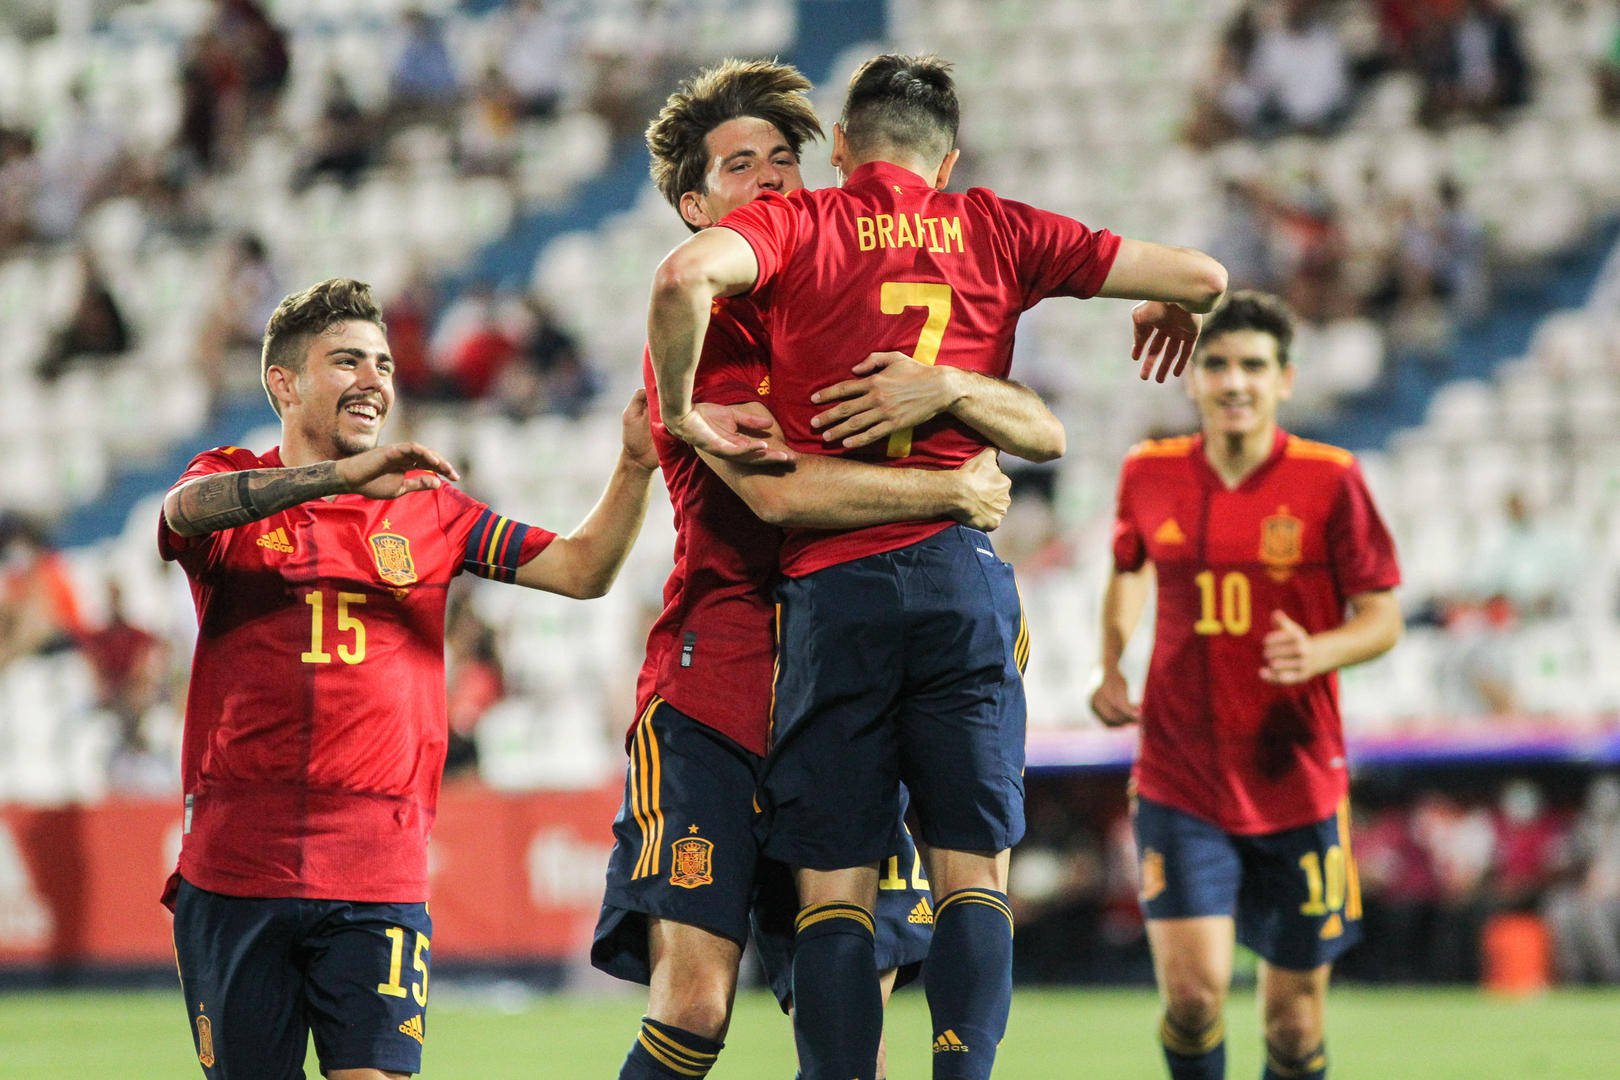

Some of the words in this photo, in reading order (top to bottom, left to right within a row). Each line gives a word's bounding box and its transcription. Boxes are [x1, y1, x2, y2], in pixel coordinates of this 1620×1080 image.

[880, 282, 952, 458] 7
[256, 538, 294, 553] adidas
[301, 590, 366, 664] 15
[1194, 571, 1250, 635] 10
[1299, 845, 1346, 916] 10
[377, 926, 430, 1007] 15
